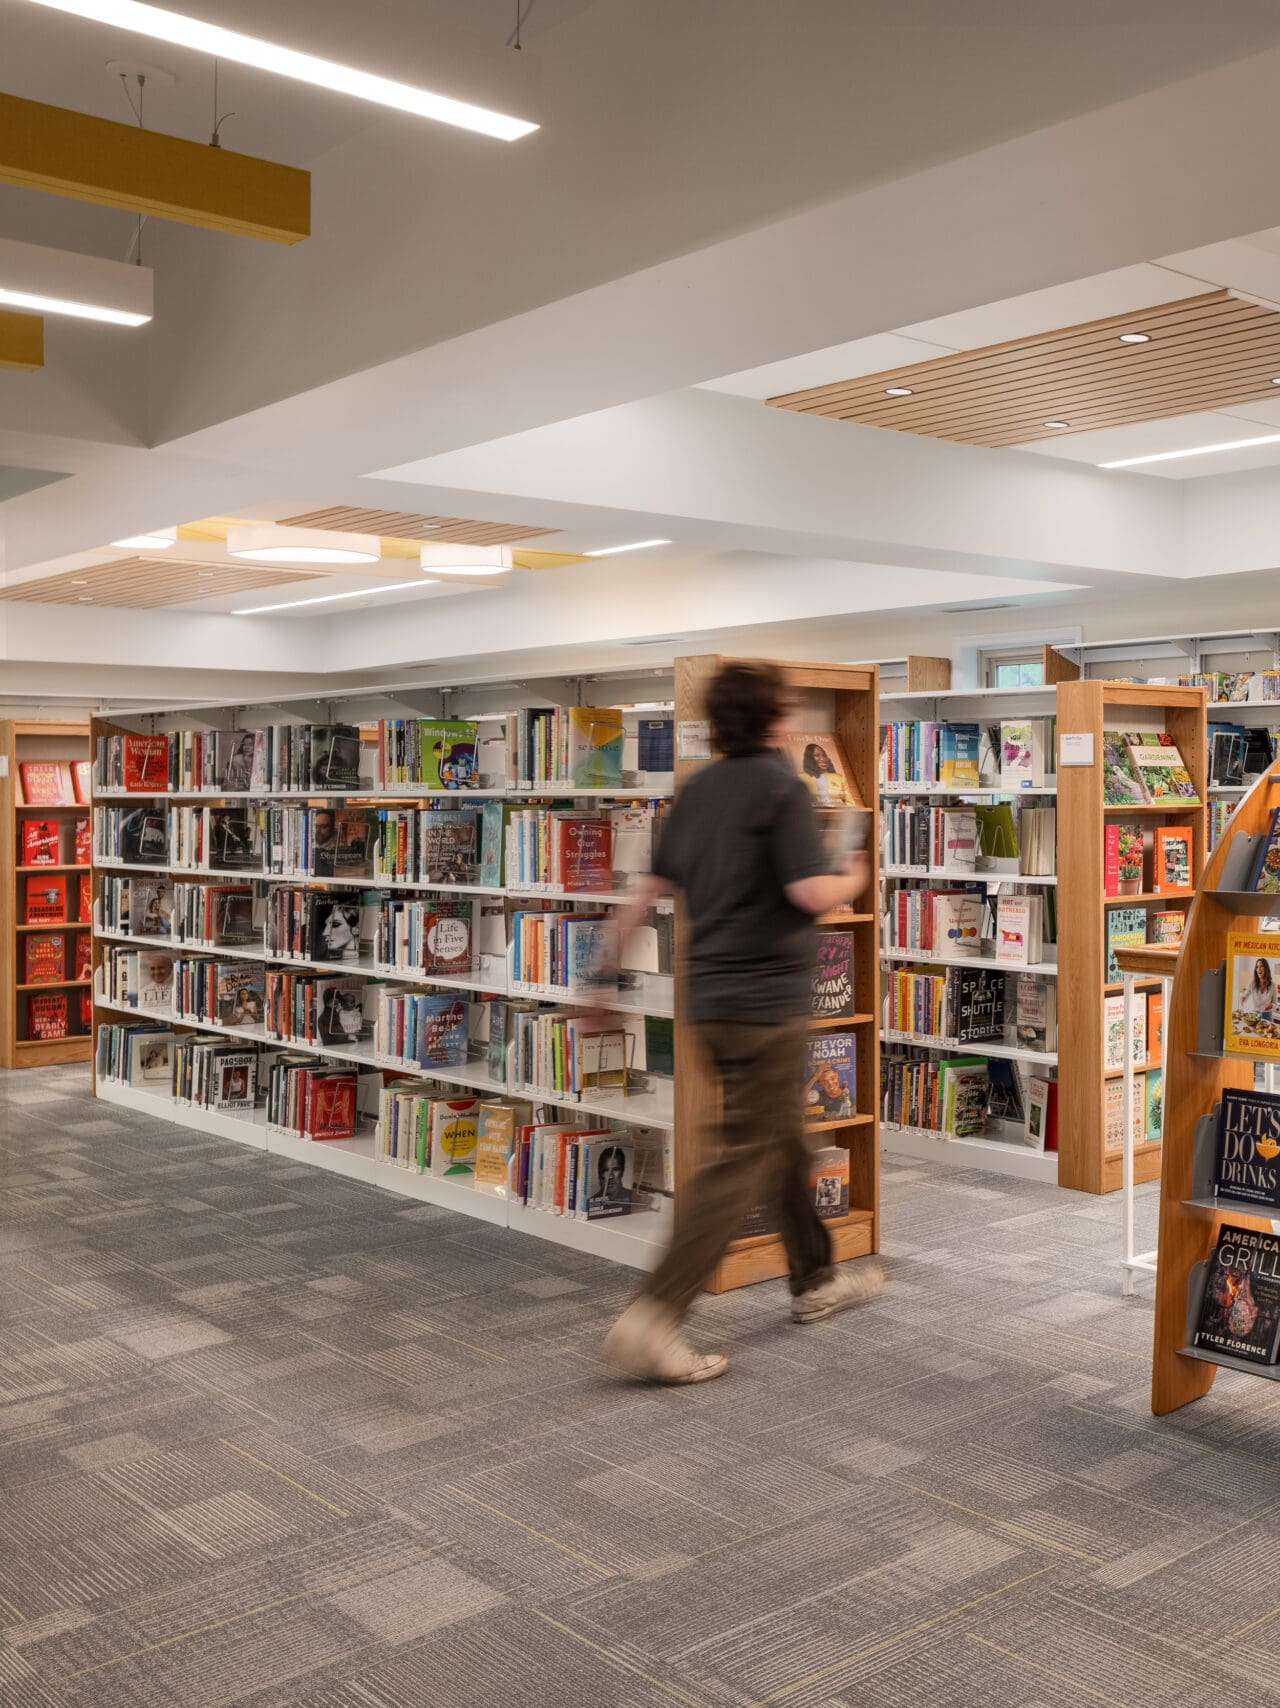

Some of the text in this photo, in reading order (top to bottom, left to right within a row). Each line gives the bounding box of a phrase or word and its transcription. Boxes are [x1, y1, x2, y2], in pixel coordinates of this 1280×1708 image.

[1140, 753, 1177, 761] GARDENING
[440, 924, 459, 932] Life
[444, 934, 464, 943] Five
[434, 944, 464, 953] Senses
[1243, 942, 1267, 950] MEXICAN
[816, 947, 837, 960] RY
[821, 959, 849, 978] NIGHT
[811, 972, 849, 993] KWAME
[962, 979, 1005, 994] SPCE
[812, 985, 853, 1010] EXANDER
[961, 1001, 1004, 1017] SHUTTLE
[426, 1014, 463, 1023] Martha
[35, 1021, 66, 1031] DEADLY
[432, 1023, 457, 1032] Beck
[41, 1029, 66, 1038] GAME
[807, 1039, 852, 1050] TREVOR
[1251, 1040, 1279, 1050] LONGORIA
[813, 1048, 846, 1059] NOAH
[1224, 1102, 1280, 1139] LET'S
[444, 1129, 475, 1140] WHEN
[1222, 1130, 1255, 1163] DO
[1221, 1159, 1277, 1190] DRINKS
[1200, 1332, 1267, 1356] TYLER FLORENCE
